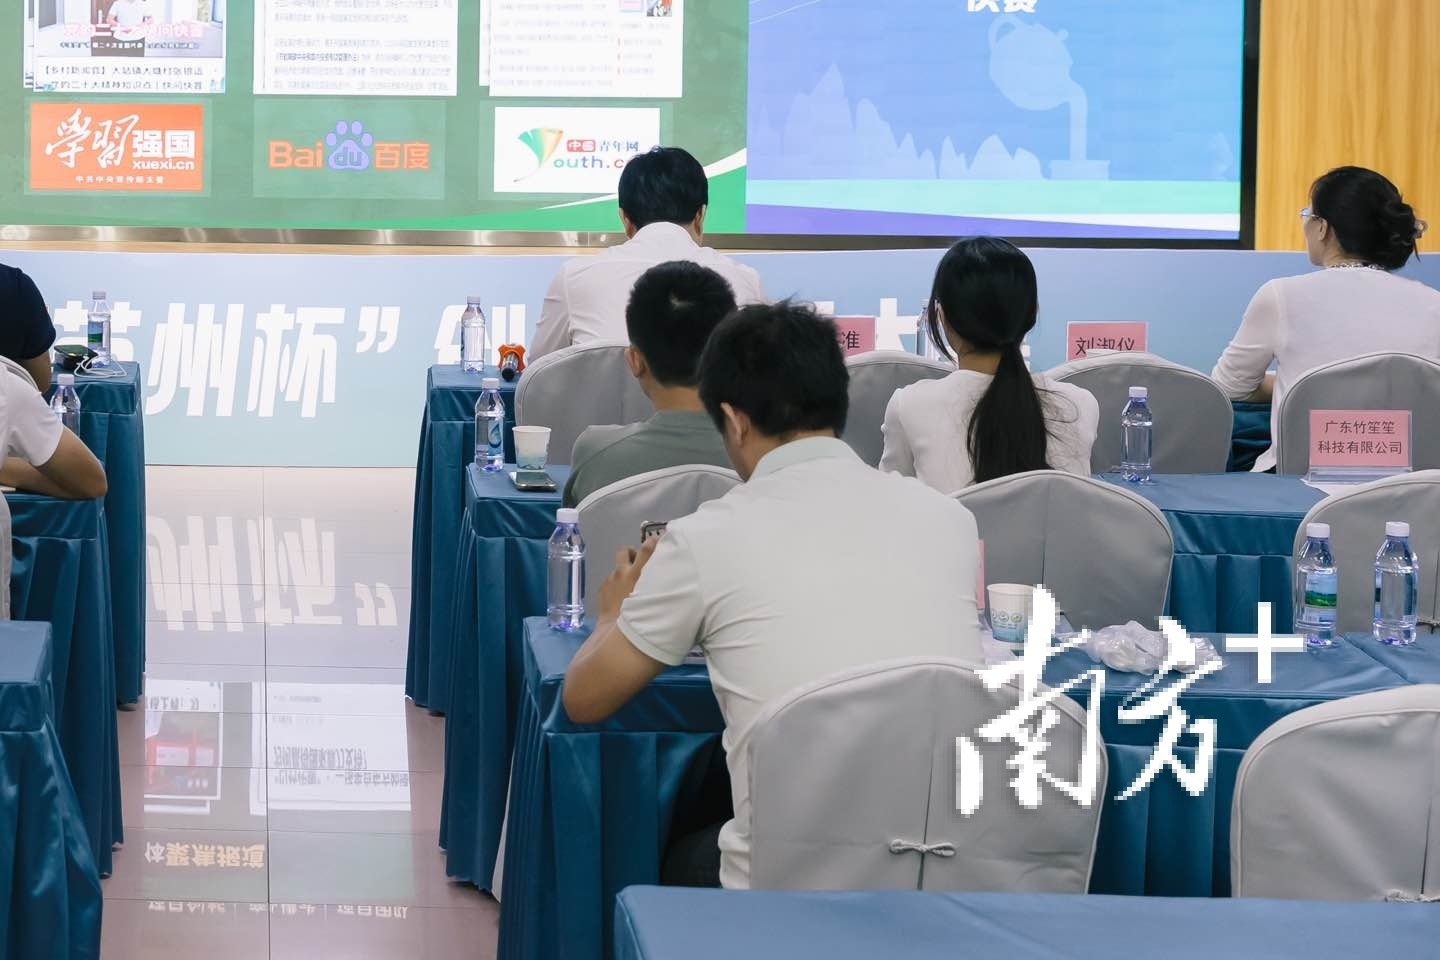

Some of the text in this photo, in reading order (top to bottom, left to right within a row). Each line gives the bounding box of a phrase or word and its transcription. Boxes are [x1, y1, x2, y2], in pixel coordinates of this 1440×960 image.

[131, 158, 195, 171] xuexi.cn
[1317, 439, 1403, 455] 科技有限公司
